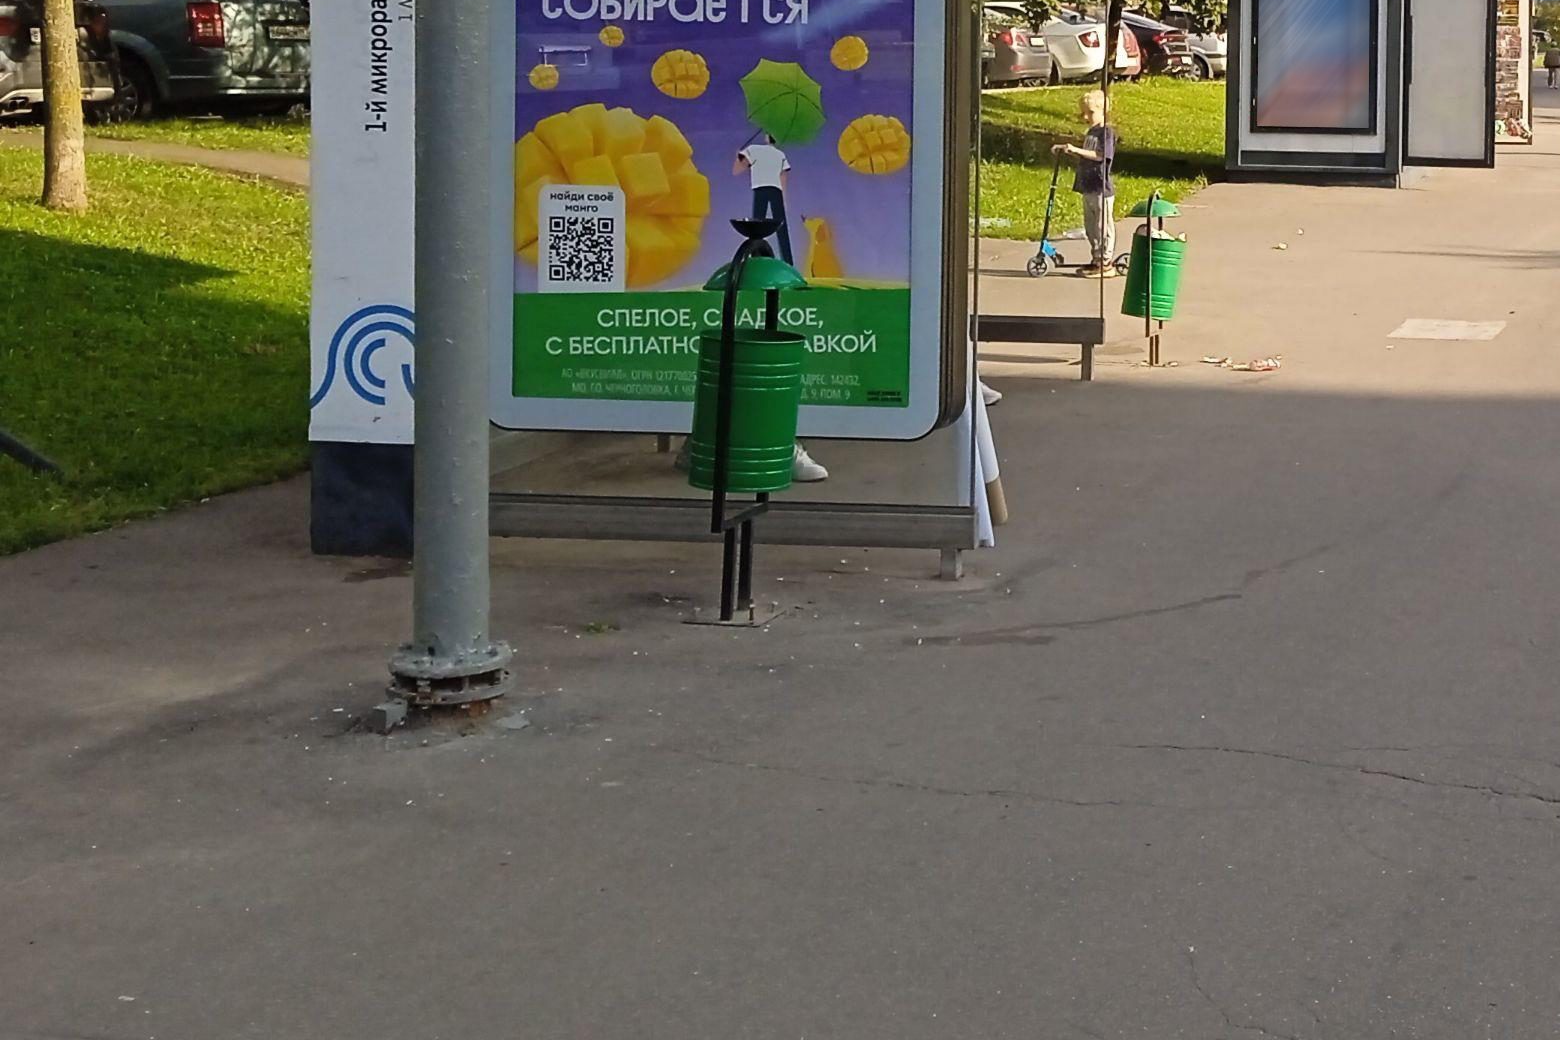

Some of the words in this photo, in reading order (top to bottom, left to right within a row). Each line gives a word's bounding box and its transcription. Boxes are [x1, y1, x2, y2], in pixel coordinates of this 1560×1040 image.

[364, 100, 388, 133] 1-й
[549, 190, 585, 202] найди
[586, 191, 614, 202] своё
[564, 204, 599, 213] манго
[597, 308, 698, 330] СПЕЛОЕ,
[703, 307, 824, 330] САДКОЕ,
[545, 336, 563, 355] С
[569, 335, 701, 355] БЕСПЛАТНО
